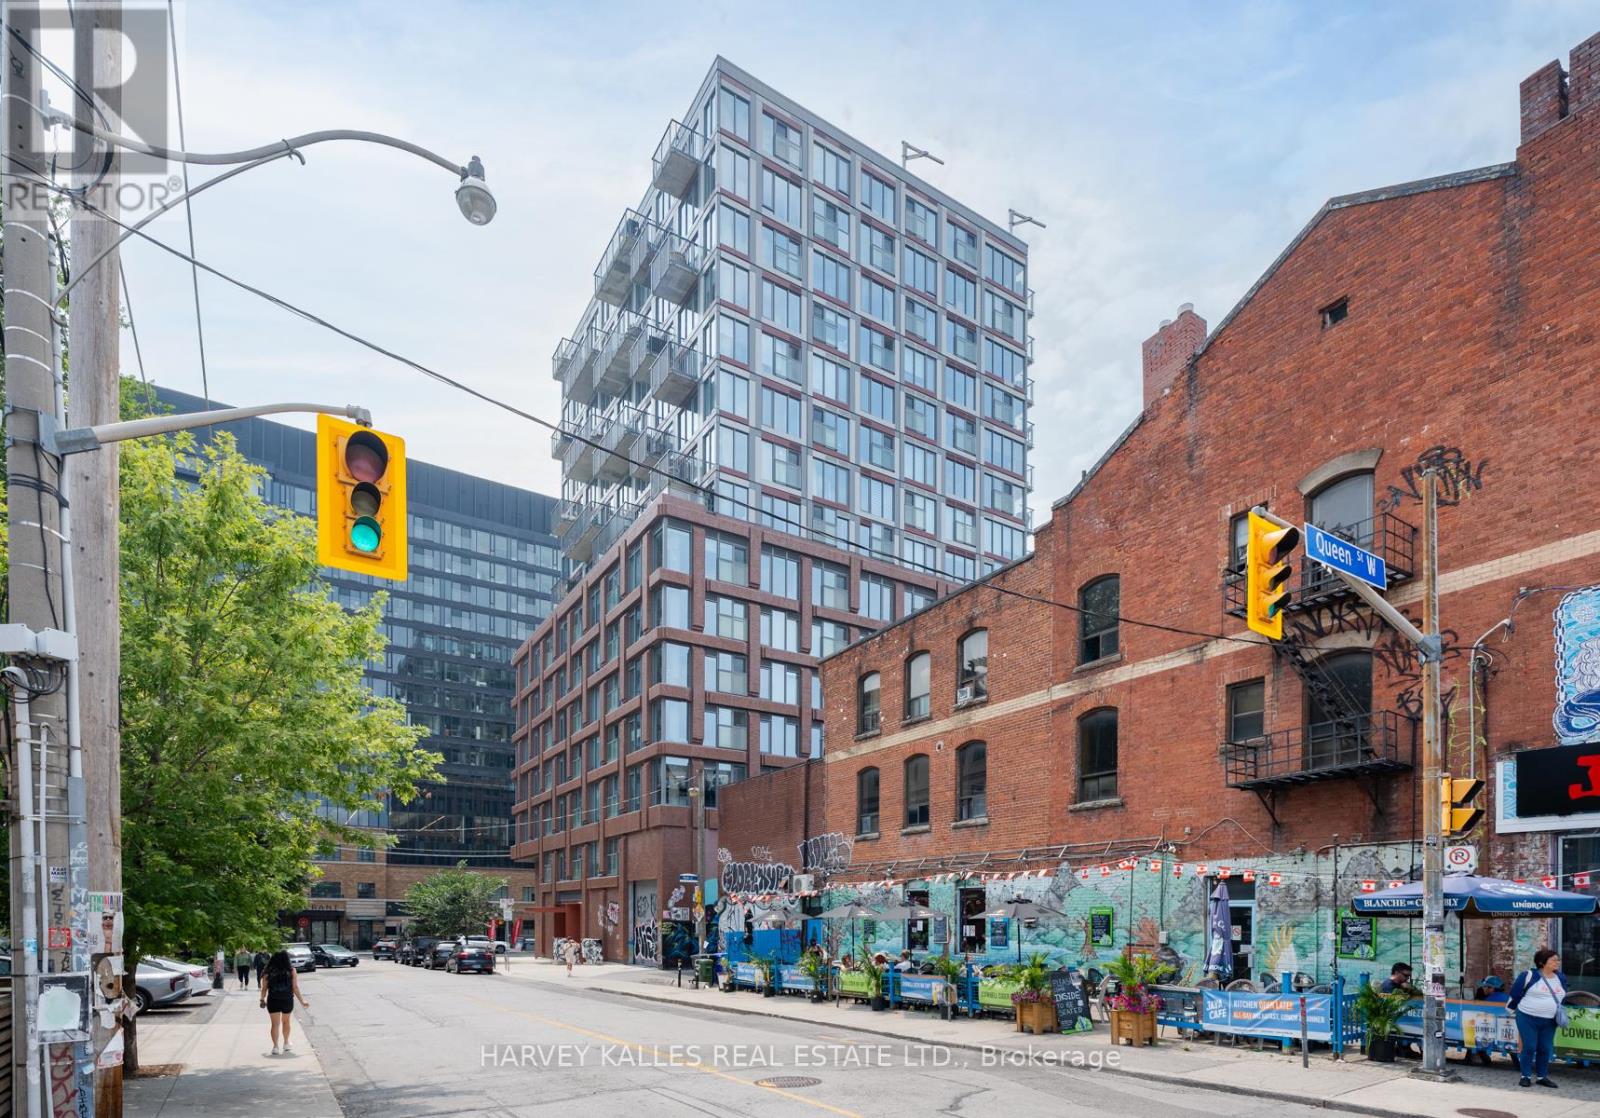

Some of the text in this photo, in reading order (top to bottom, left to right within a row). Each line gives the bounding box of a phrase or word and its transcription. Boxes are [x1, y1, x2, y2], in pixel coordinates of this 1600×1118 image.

[1316, 533, 1376, 577] Queen St W
[1363, 898, 1406, 908] BLANCHE
[1055, 991, 1081, 1002] INSIDE
[1233, 1000, 1258, 1009] KITCHEN
[1561, 1027, 1600, 1040] COWBE
